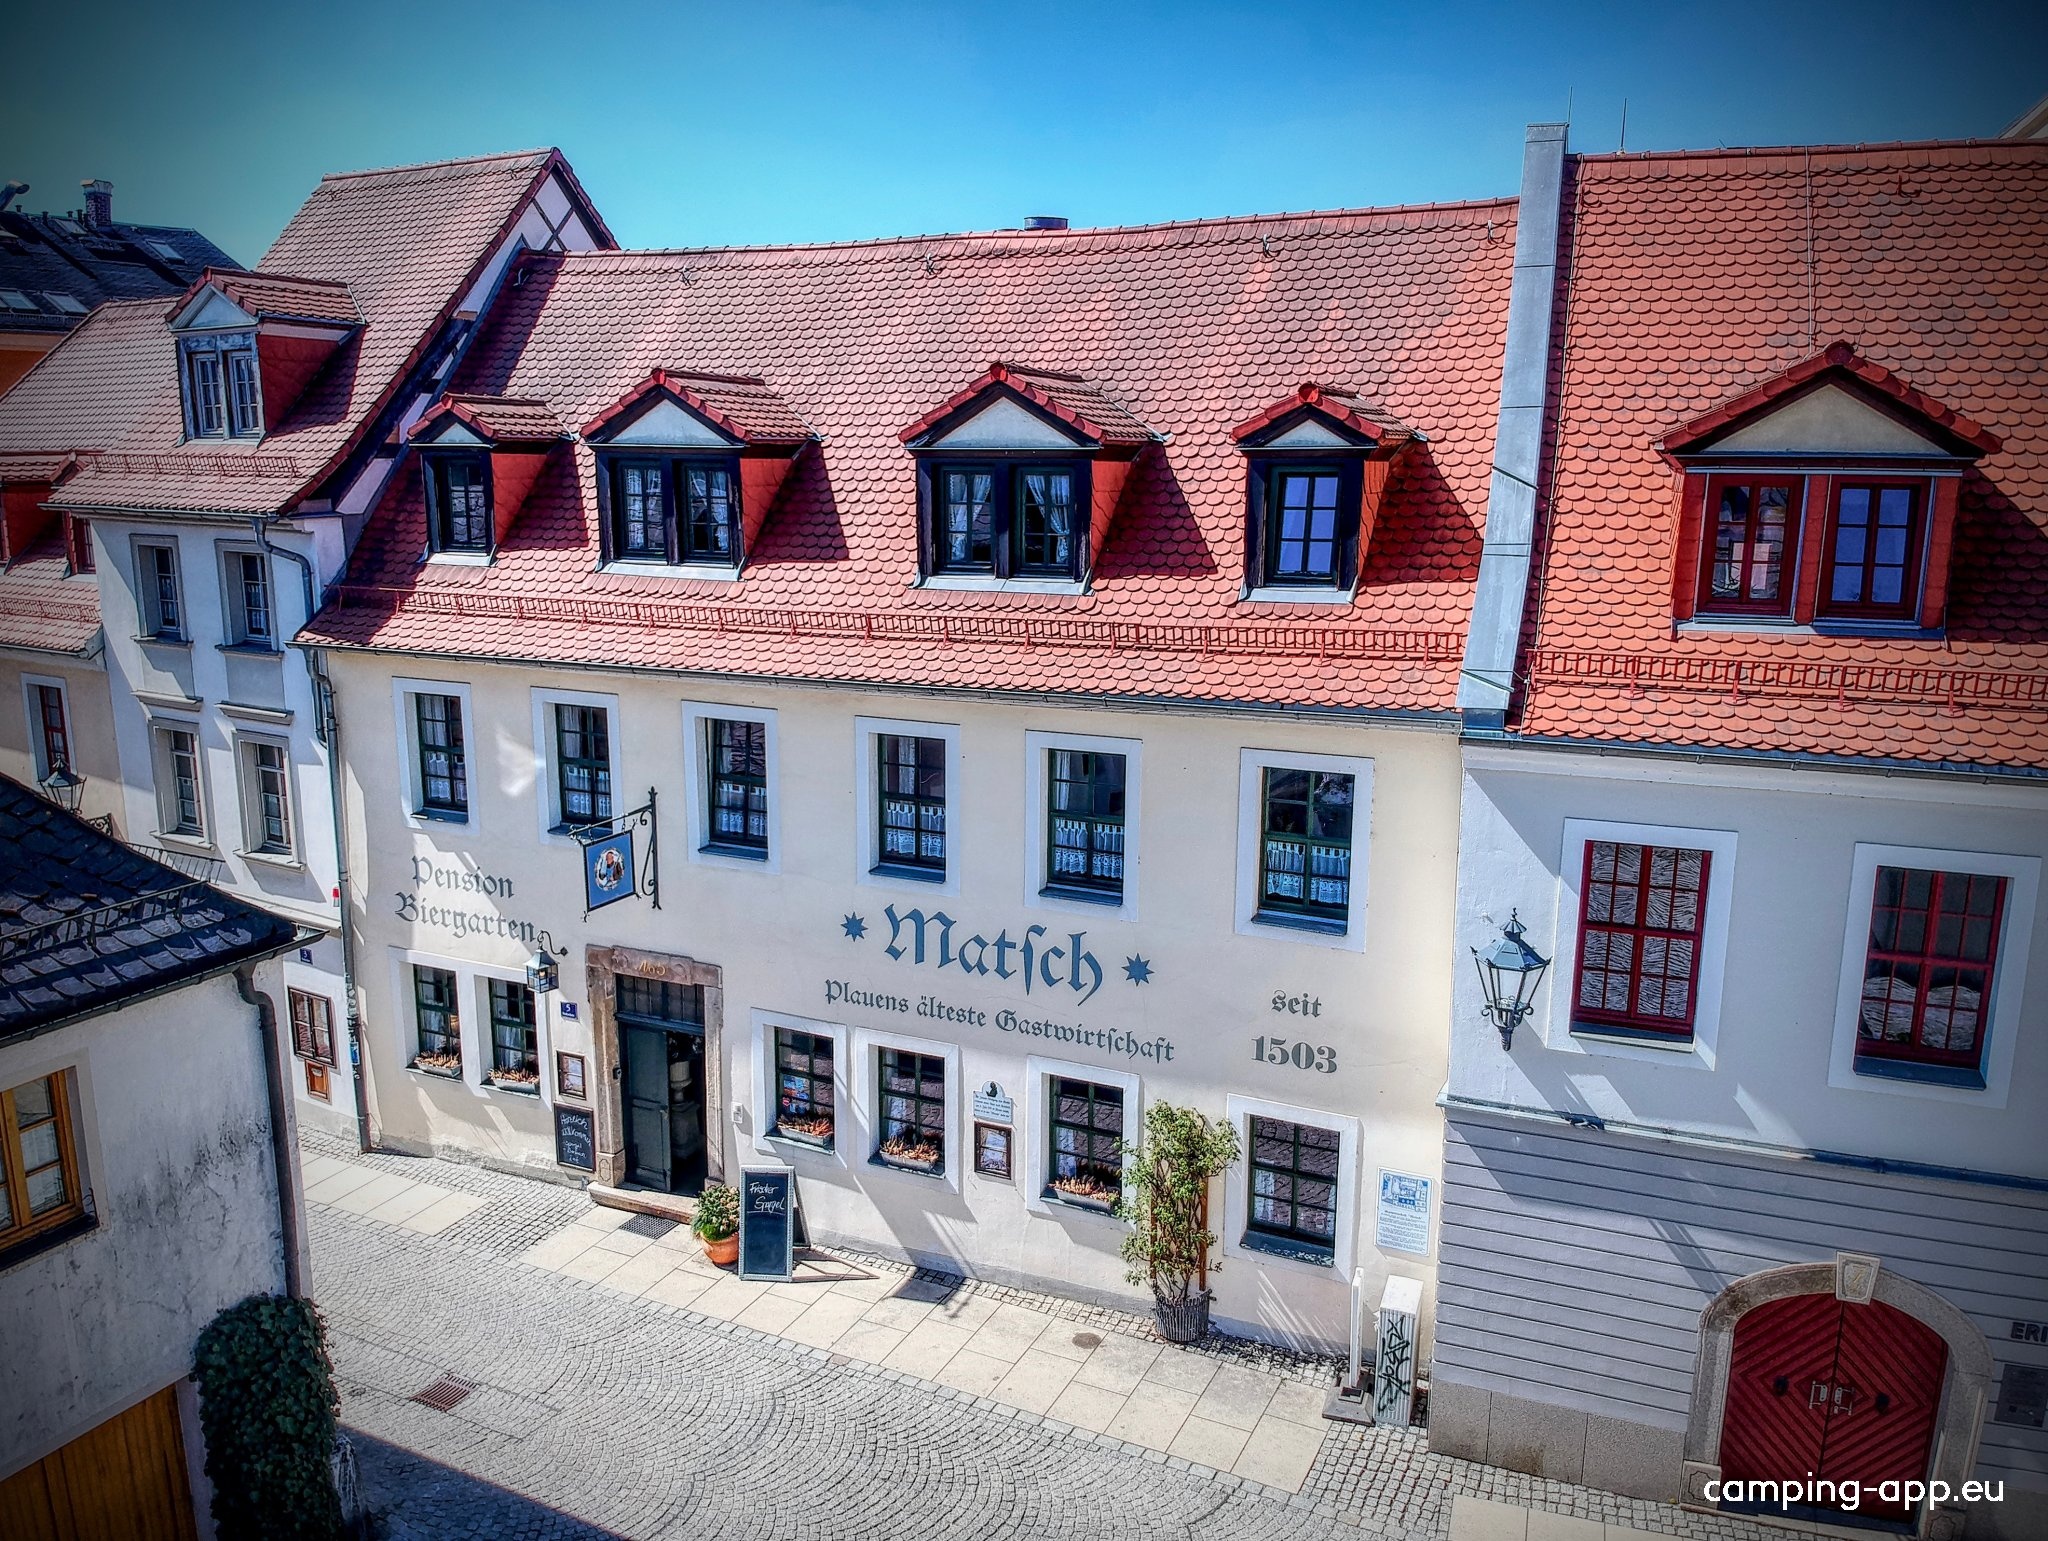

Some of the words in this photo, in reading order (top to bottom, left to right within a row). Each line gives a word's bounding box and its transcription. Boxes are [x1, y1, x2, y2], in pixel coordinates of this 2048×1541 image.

[412, 855, 514, 899] Pension
[395, 892, 536, 942] Biergarten
[825, 979, 909, 1013] Plauens
[916, 995, 986, 1026] älteste
[1251, 1035, 1338, 1073] 1503
